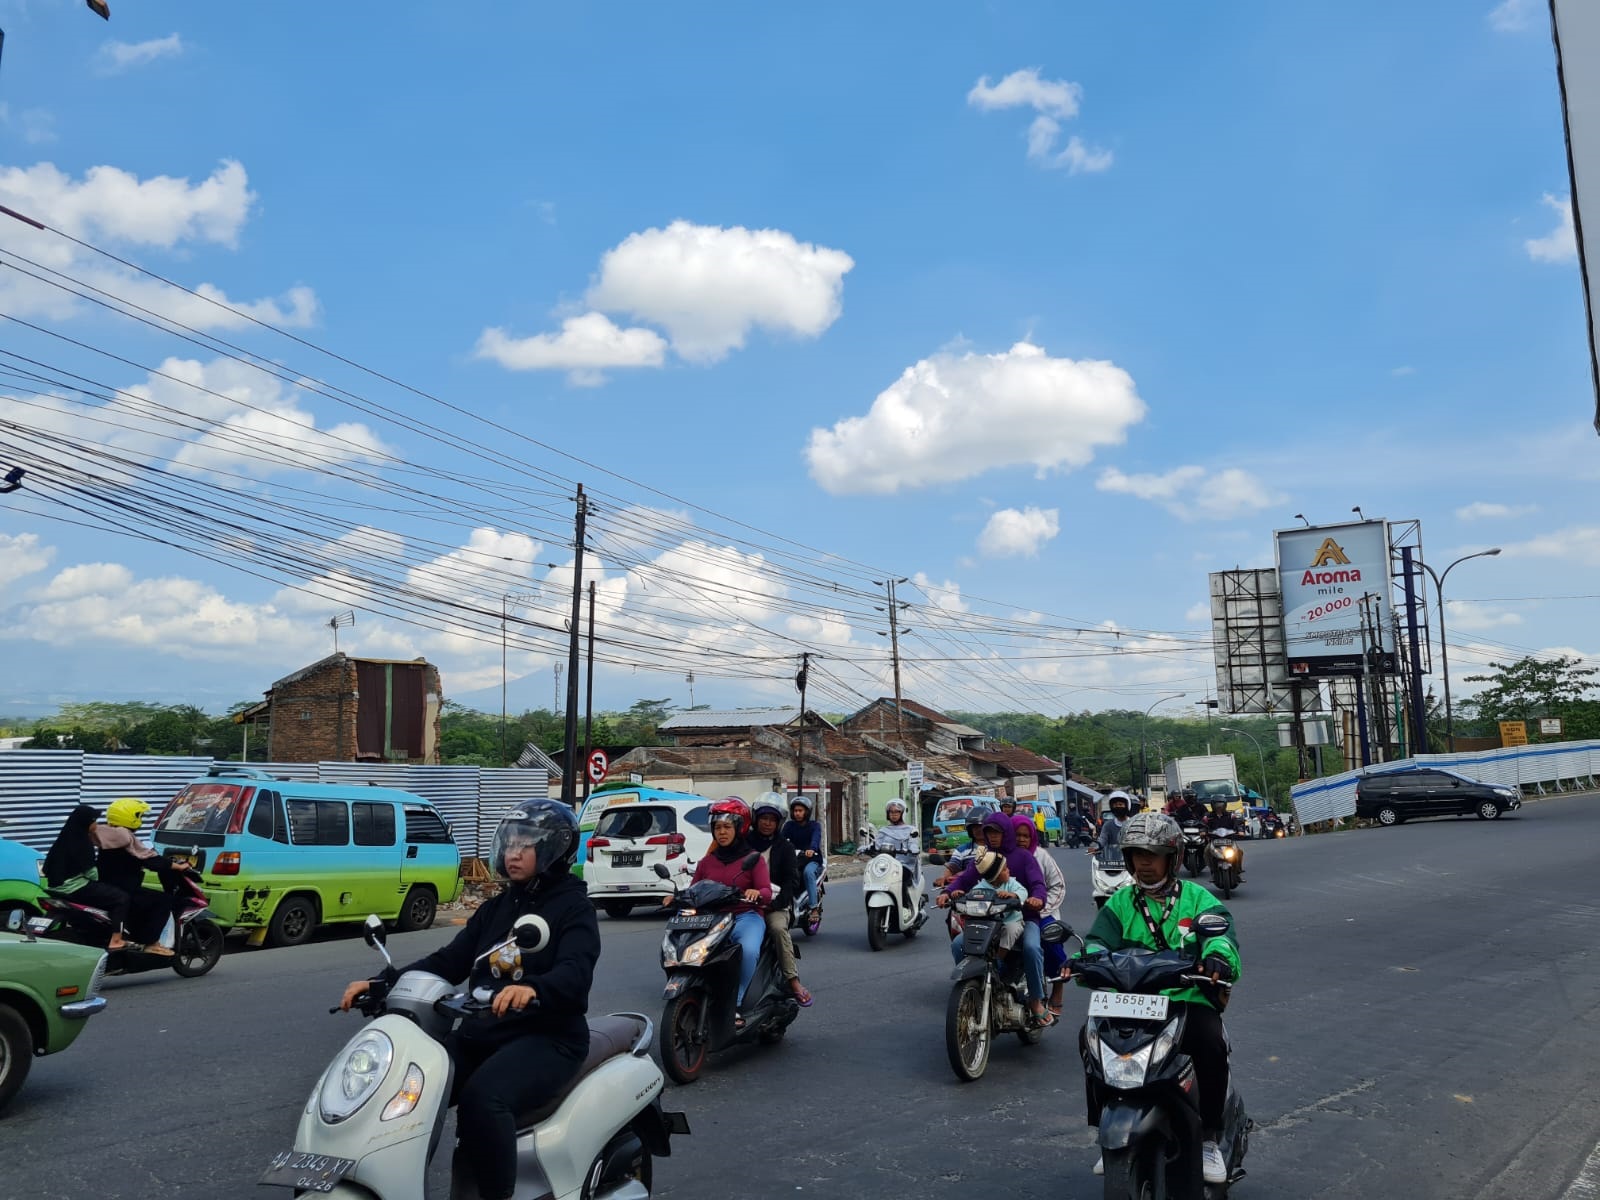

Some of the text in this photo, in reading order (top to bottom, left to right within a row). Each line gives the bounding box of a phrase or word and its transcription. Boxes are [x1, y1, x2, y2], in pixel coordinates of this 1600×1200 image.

[1301, 569, 1361, 586] Aroma
[1318, 585, 1344, 596] mile
[1307, 597, 1351, 620] 20.000
[1093, 994, 1166, 1007] AA 5658 WT
[291, 1153, 330, 1171] 2349
